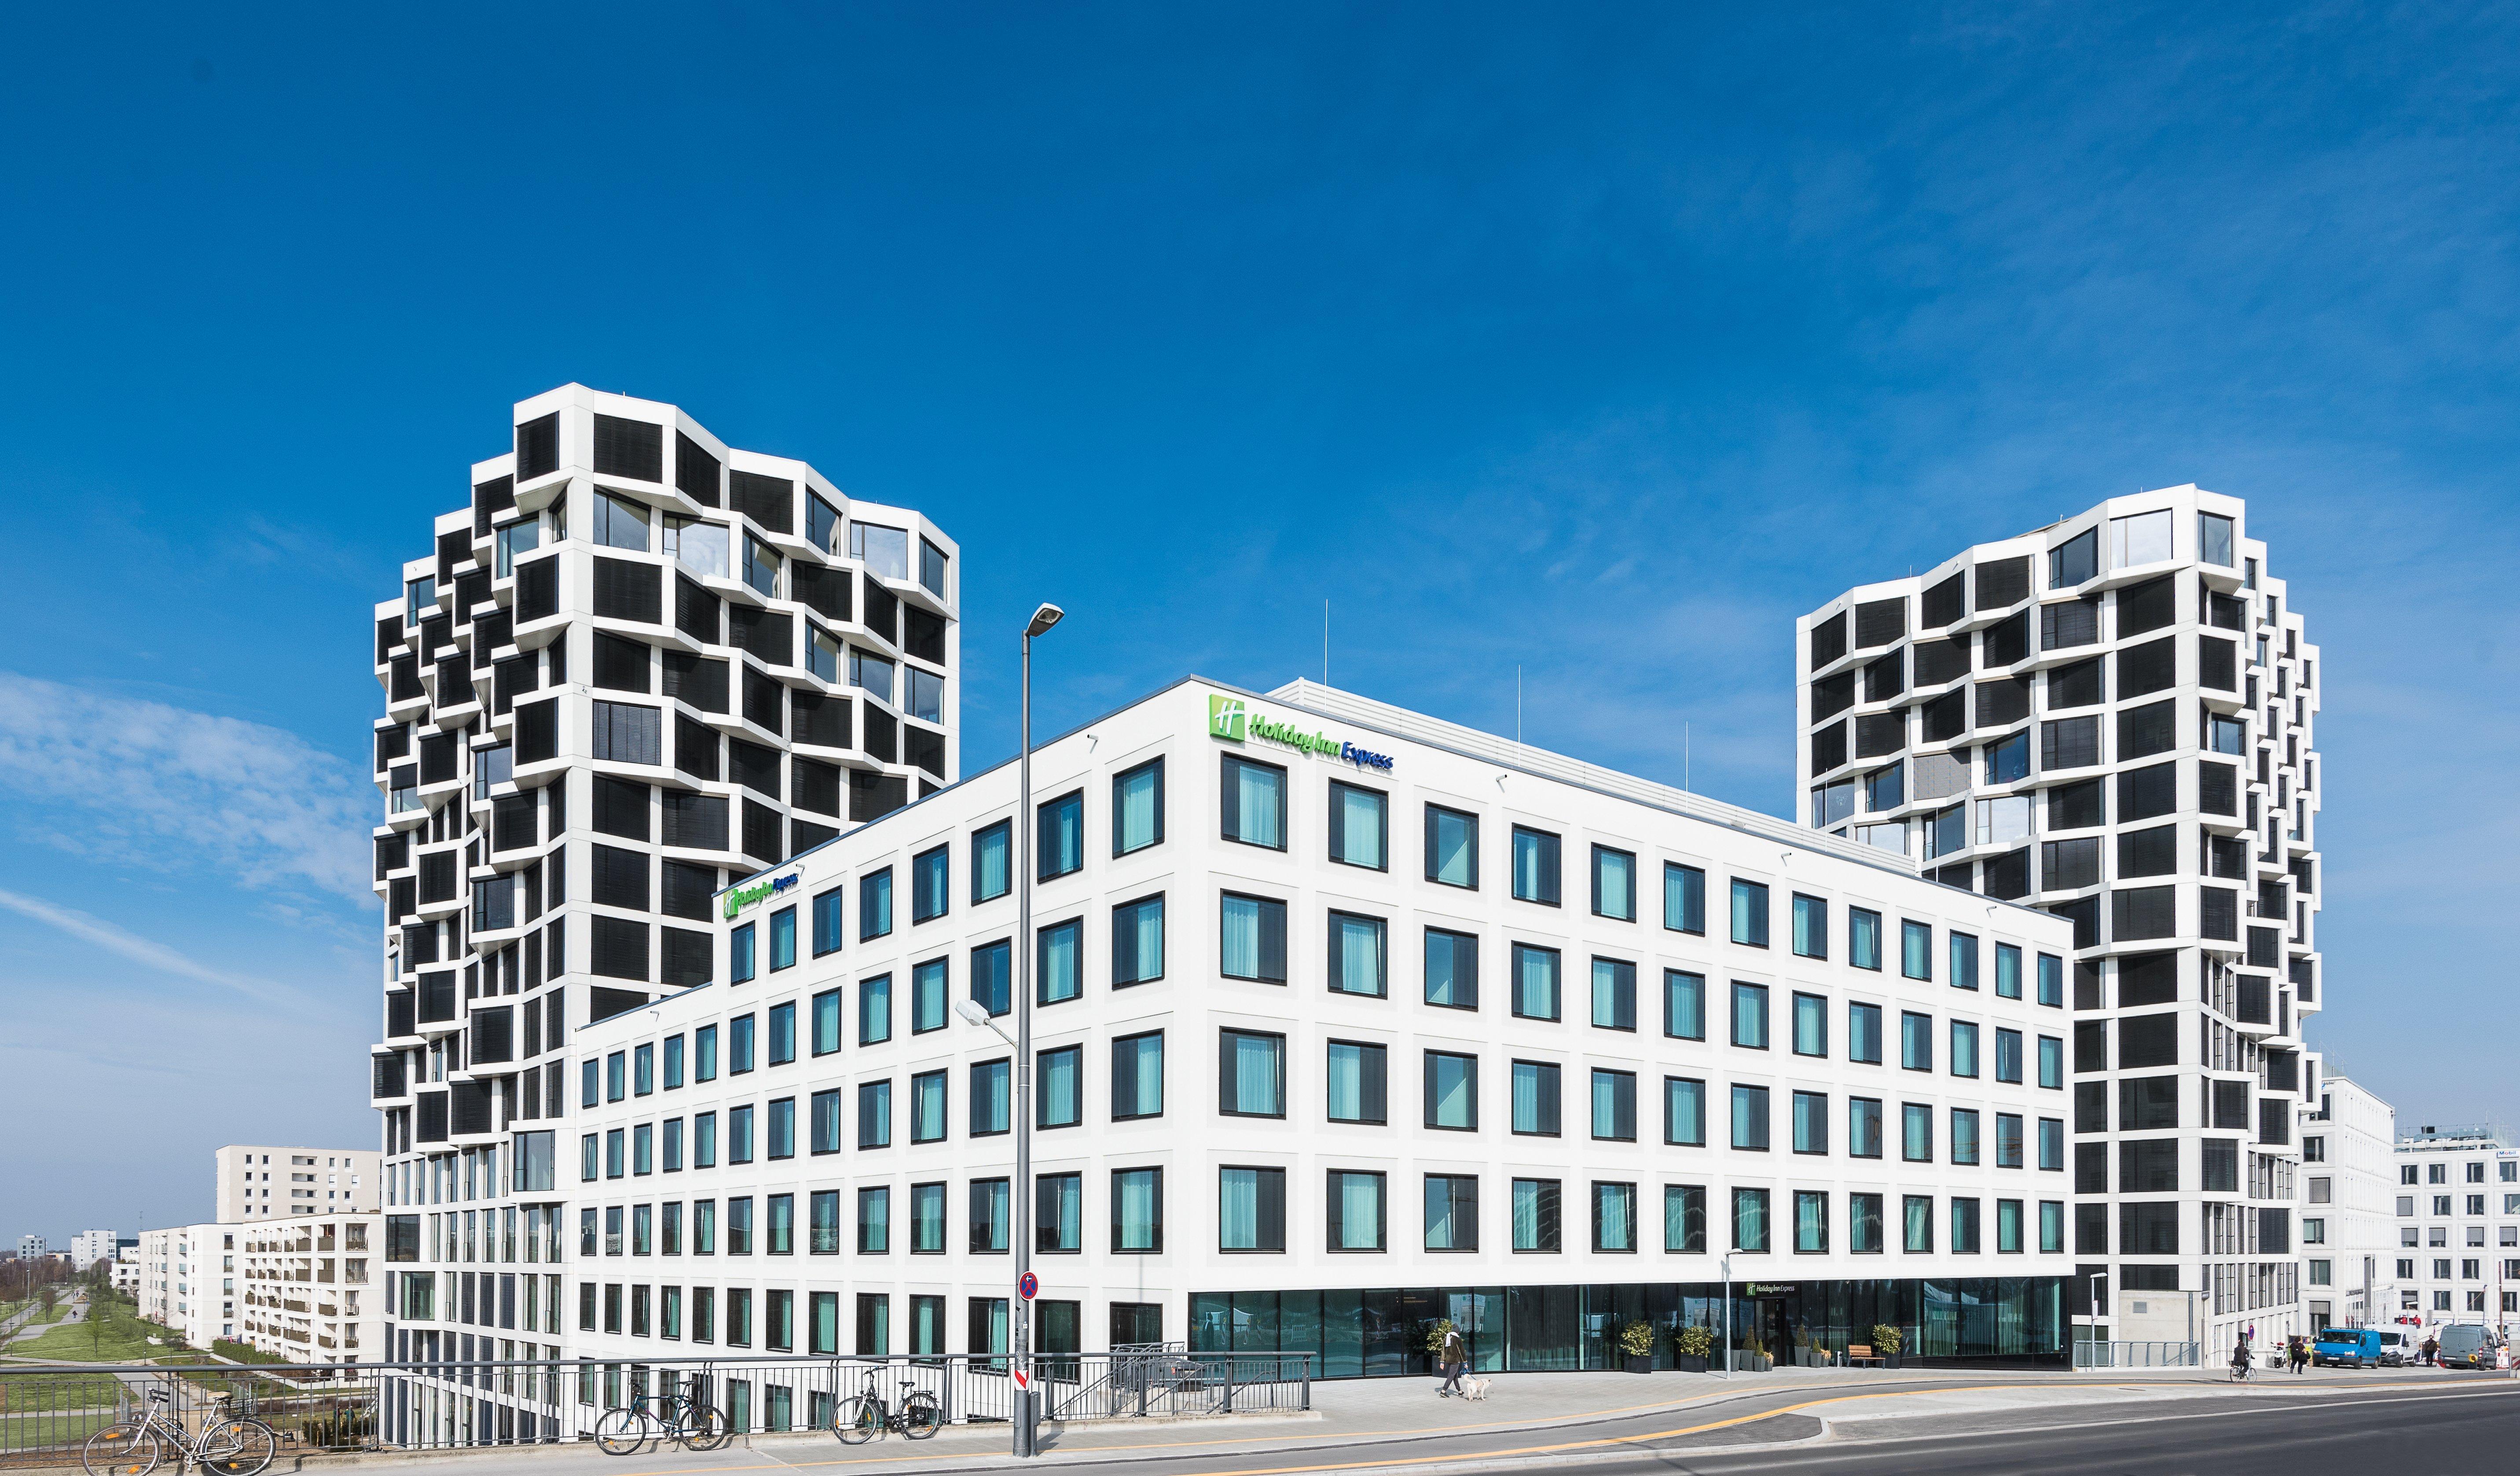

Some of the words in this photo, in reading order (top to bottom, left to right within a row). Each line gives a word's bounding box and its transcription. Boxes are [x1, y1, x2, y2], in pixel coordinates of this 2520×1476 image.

[1249, 713, 1314, 753] Holiday
[1314, 731, 1341, 756] Inn
[1341, 741, 1394, 770] Express
[1756, 1284, 1773, 1293] Holiday
